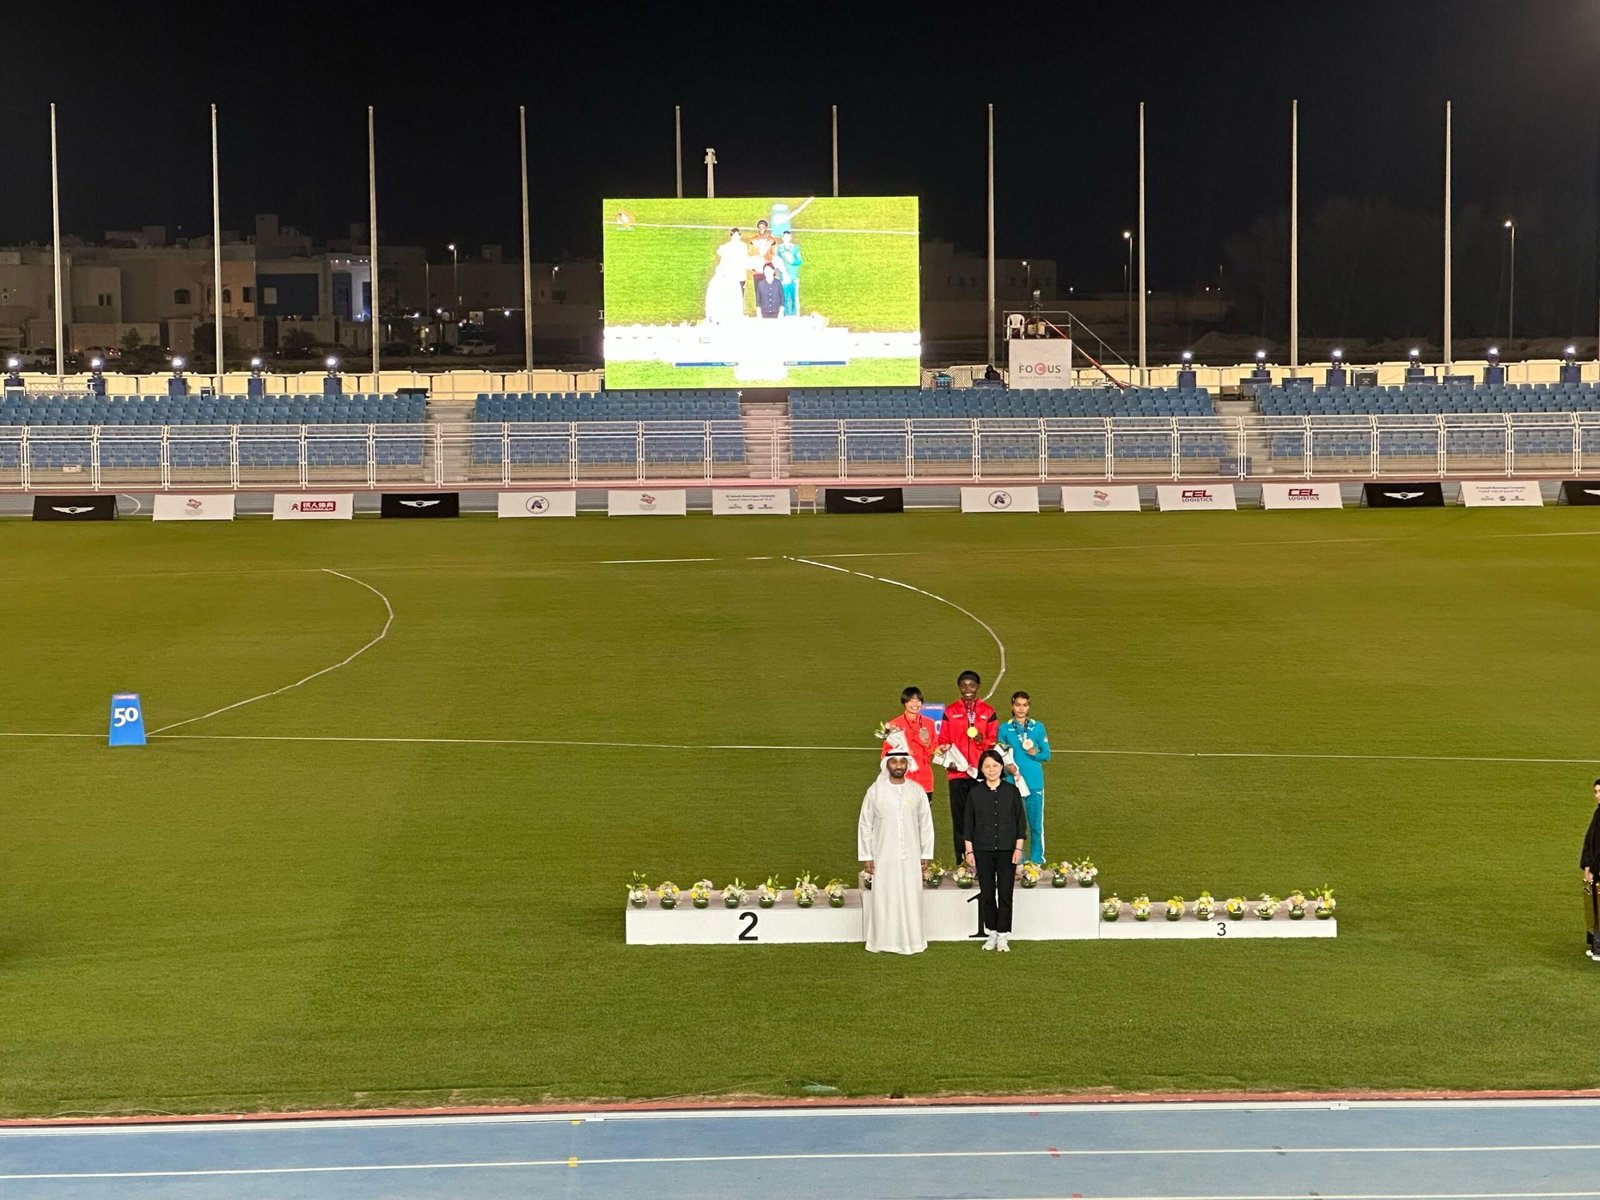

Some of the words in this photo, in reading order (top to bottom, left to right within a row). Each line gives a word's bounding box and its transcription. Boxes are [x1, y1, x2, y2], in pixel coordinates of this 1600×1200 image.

[1019, 362, 1061, 375] FOCUS
[1182, 490, 1212, 498] CEL
[114, 707, 139, 727] 50
[739, 911, 758, 941] 2
[1217, 922, 1227, 936] 3
